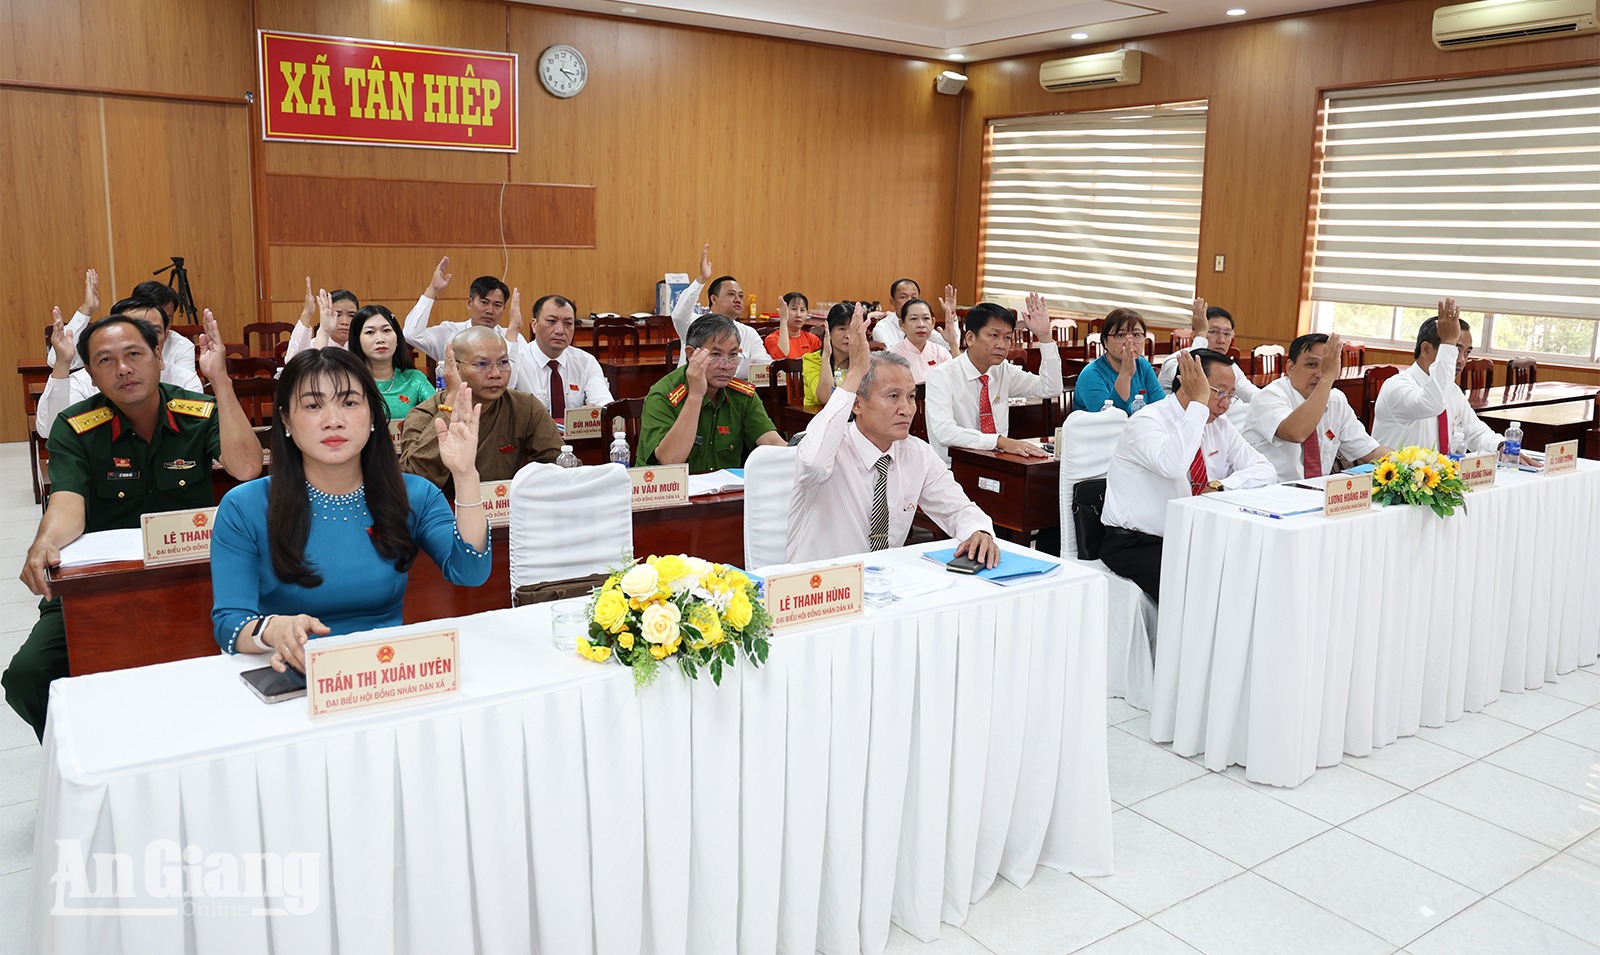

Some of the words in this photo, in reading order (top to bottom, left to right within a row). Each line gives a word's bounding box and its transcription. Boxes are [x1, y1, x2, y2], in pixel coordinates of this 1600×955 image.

[279, 54, 336, 116] XÃ
[344, 55, 415, 121] TÂN
[423, 63, 501, 137] HIỆP
[573, 419, 583, 428] BÙI
[585, 419, 601, 427] HOÀN
[641, 482, 658, 494] VĂN
[659, 480, 680, 493] MƯỜI
[495, 498, 510, 509] NH
[163, 531, 177, 545] LÊ
[167, 545, 180, 554] BIỂU
[193, 542, 209, 551] ĐỒNG
[780, 594, 791, 611] LÊ
[793, 591, 824, 609] THANH
[826, 586, 851, 603] HÙNG
[785, 612, 797, 623] BIỂU
[798, 612, 806, 621] HỘI
[807, 608, 821, 618] ĐỒNG
[822, 606, 836, 616] NHÂN
[836, 605, 847, 613] DÂN
[318, 670, 353, 694] TRẦN
[357, 670, 377, 689] THỊ
[381, 662, 416, 685] XUÂN
[419, 657, 452, 678] UYÊN
[326, 696, 339, 709] ĐẠI
[340, 693, 358, 706] BIỂU
[360, 692, 373, 703] HỘI
[374, 689, 396, 700] ĐỒNG
[397, 684, 418, 695] NHÂN
[419, 681, 434, 692] DÂN
[435, 680, 446, 690] XÃ
